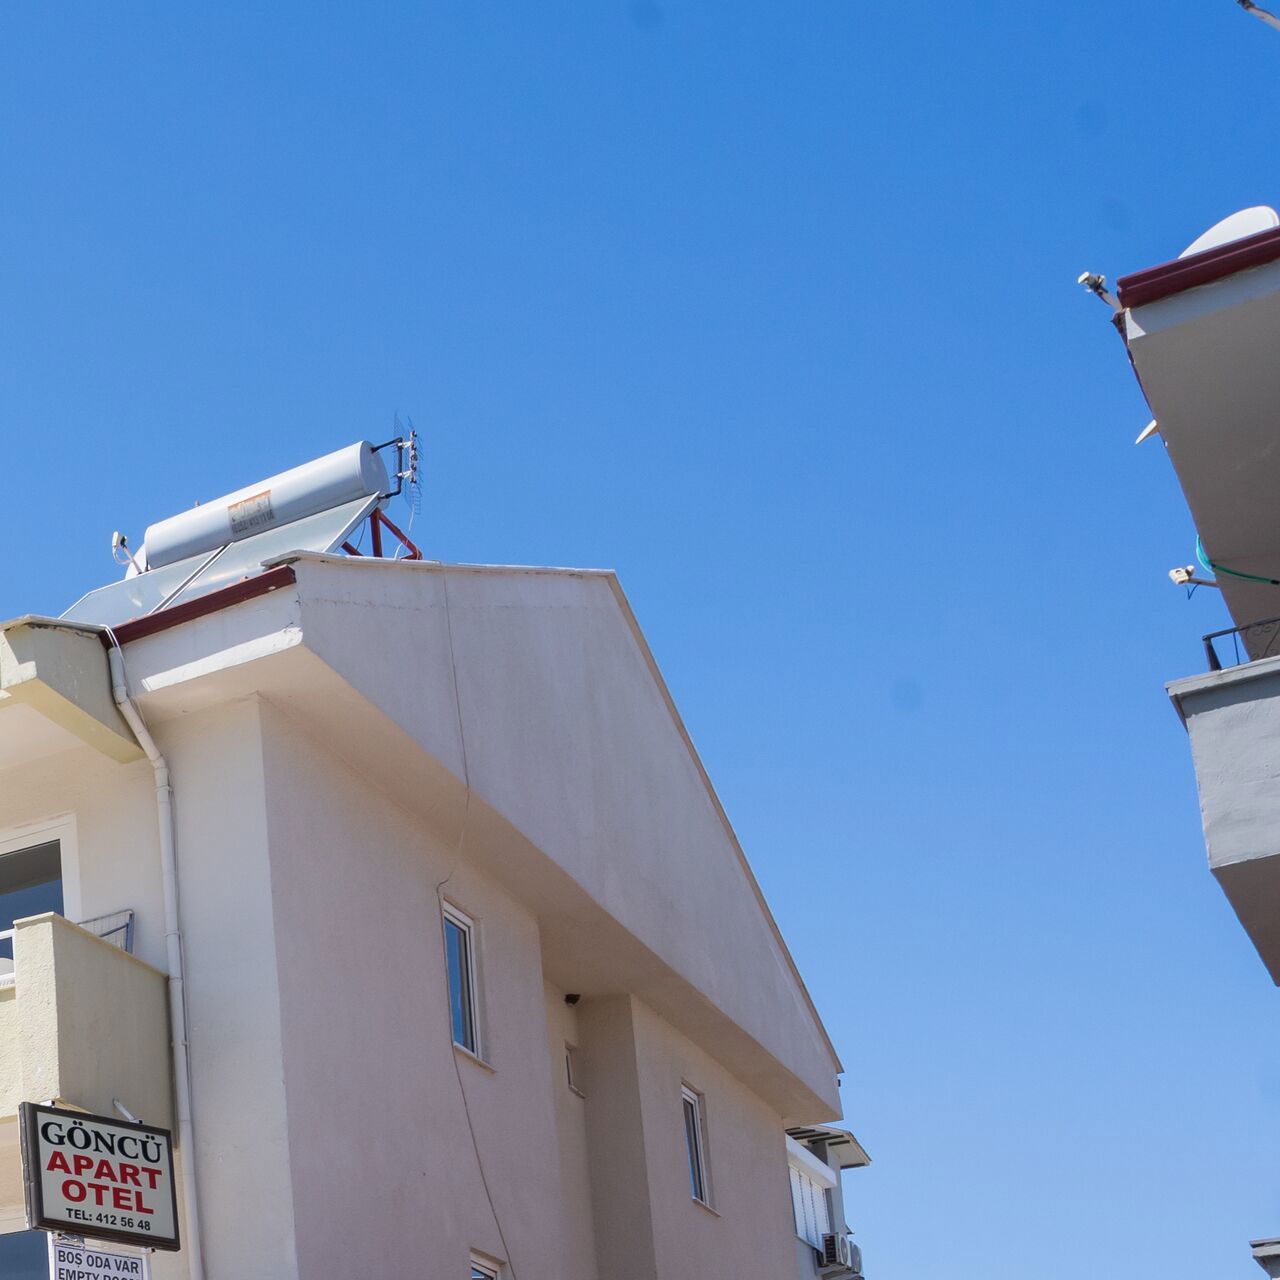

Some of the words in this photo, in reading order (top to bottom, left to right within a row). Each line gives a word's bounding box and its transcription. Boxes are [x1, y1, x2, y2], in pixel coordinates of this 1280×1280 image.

[41, 1119, 163, 1163] GÖNCÜ
[46, 1151, 163, 1189] APART
[61, 1179, 154, 1215] OTEL
[65, 1207, 93, 1222] TEL:
[95, 1211, 117, 1226] 412
[120, 1215, 134, 1228] 56
[137, 1218, 151, 1231] 48
[58, 1250, 83, 1268] BOŞ
[86, 1254, 112, 1271] ODA
[114, 1257, 139, 1274] VAR
